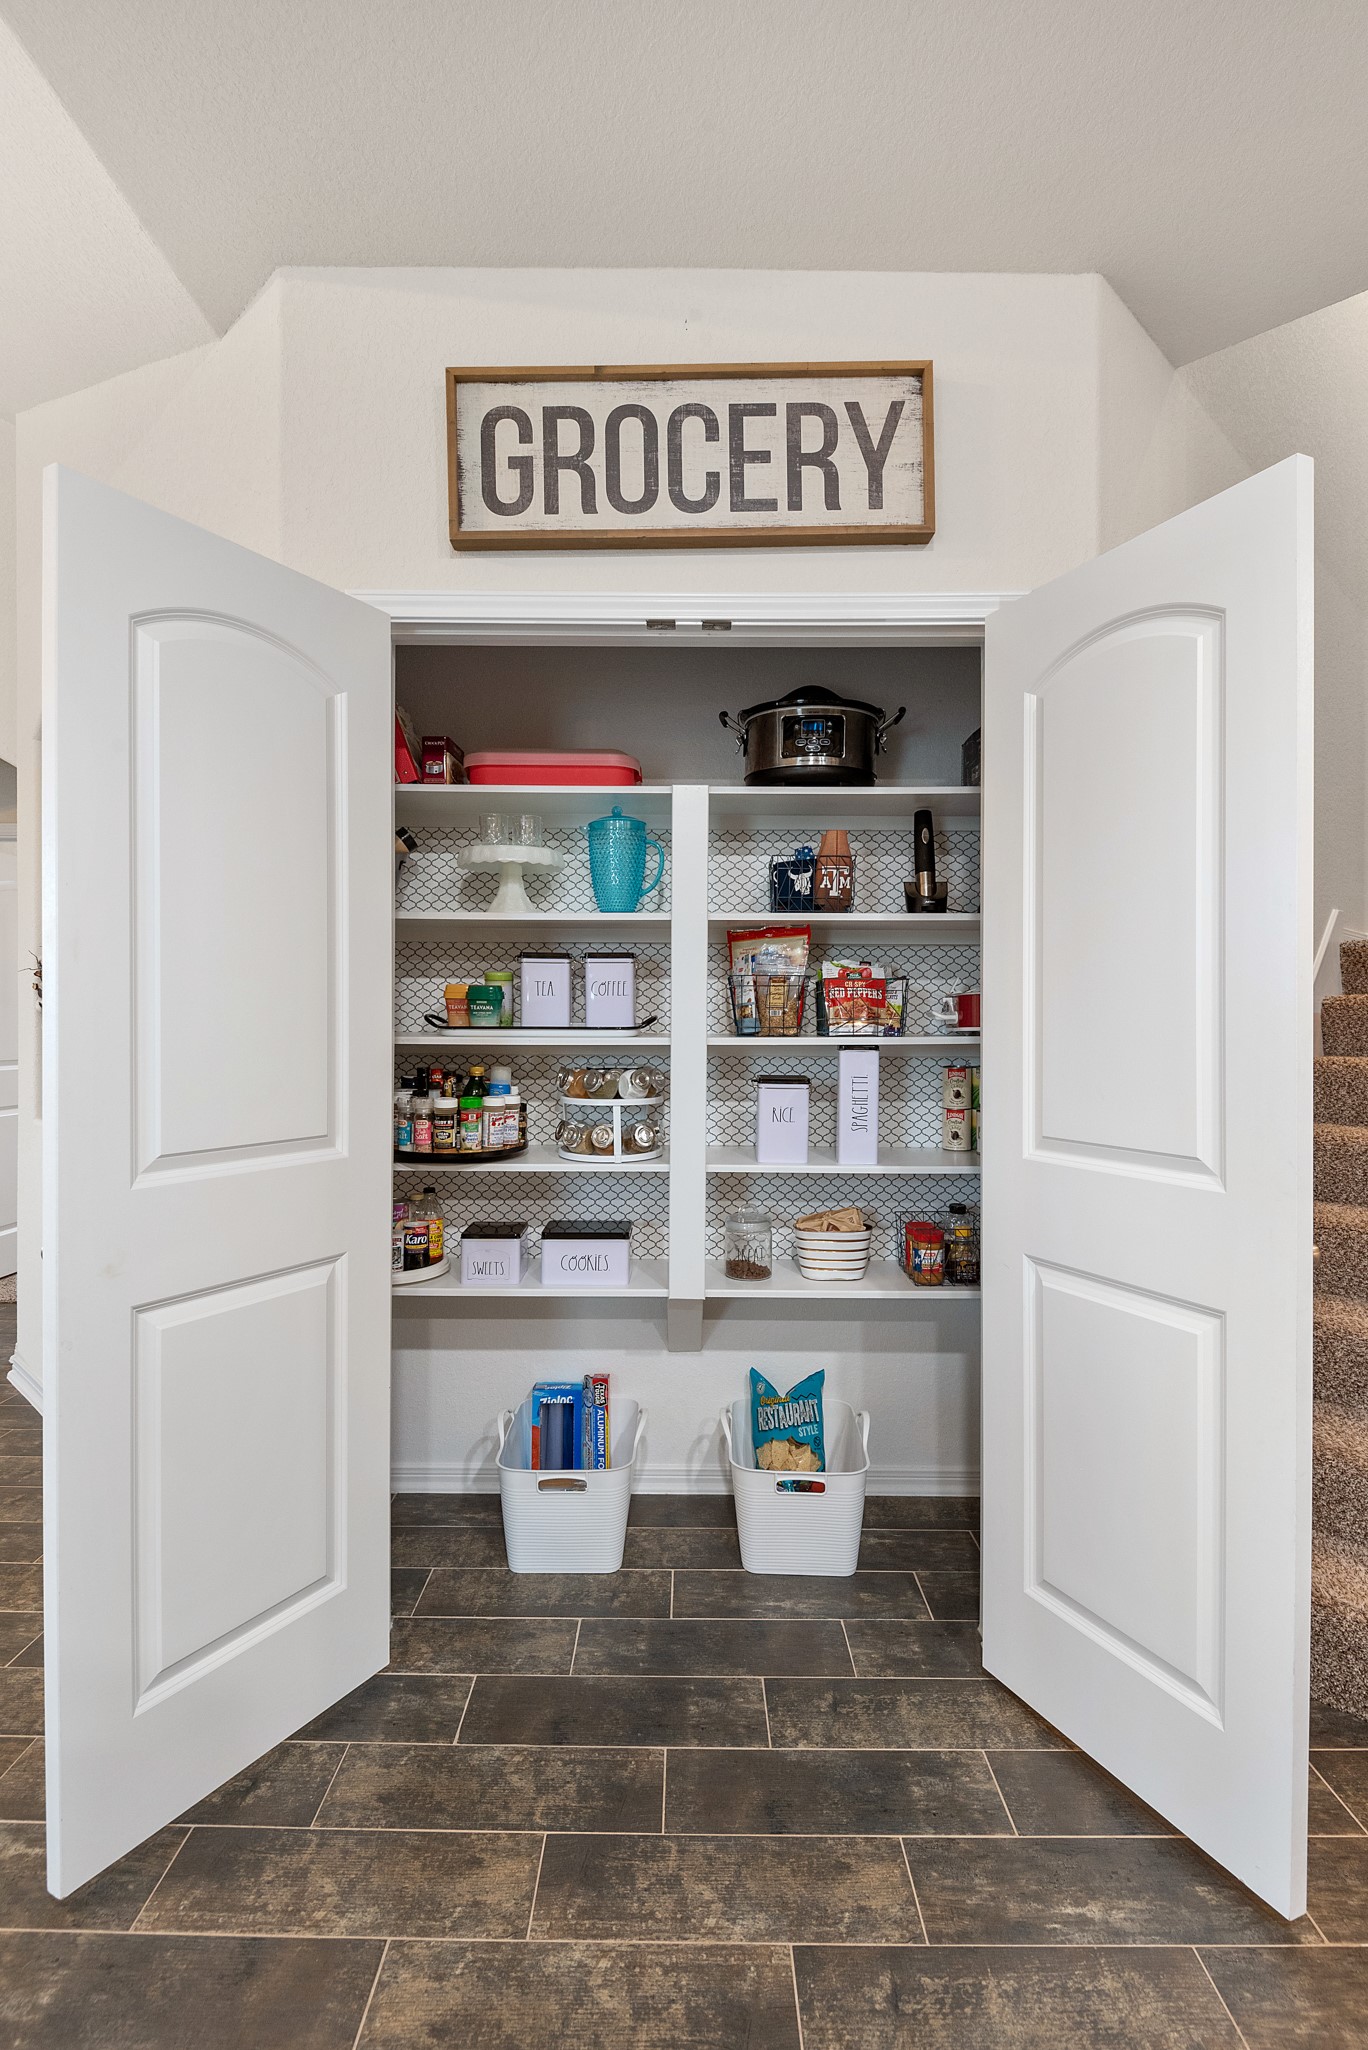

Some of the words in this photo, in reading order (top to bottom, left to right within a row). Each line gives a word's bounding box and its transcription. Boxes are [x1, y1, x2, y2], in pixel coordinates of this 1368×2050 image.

[480, 401, 906, 516] GROCERY
[534, 980, 554, 996] TEA
[591, 980, 629, 996] COFFEE
[829, 987, 845, 999] RED
[847, 987, 883, 1000] PEPPERS
[851, 1075, 869, 1133] SPAGHETTI
[772, 1106, 796, 1123] RICE
[405, 1234, 427, 1244] Karo
[472, 1261, 504, 1275] SWEETS
[560, 1254, 609, 1271] COOKIES
[757, 1399, 819, 1431] RESTAURANT
[597, 1408, 605, 1455] ALUMINUM
[798, 1424, 819, 1437] STYLE
